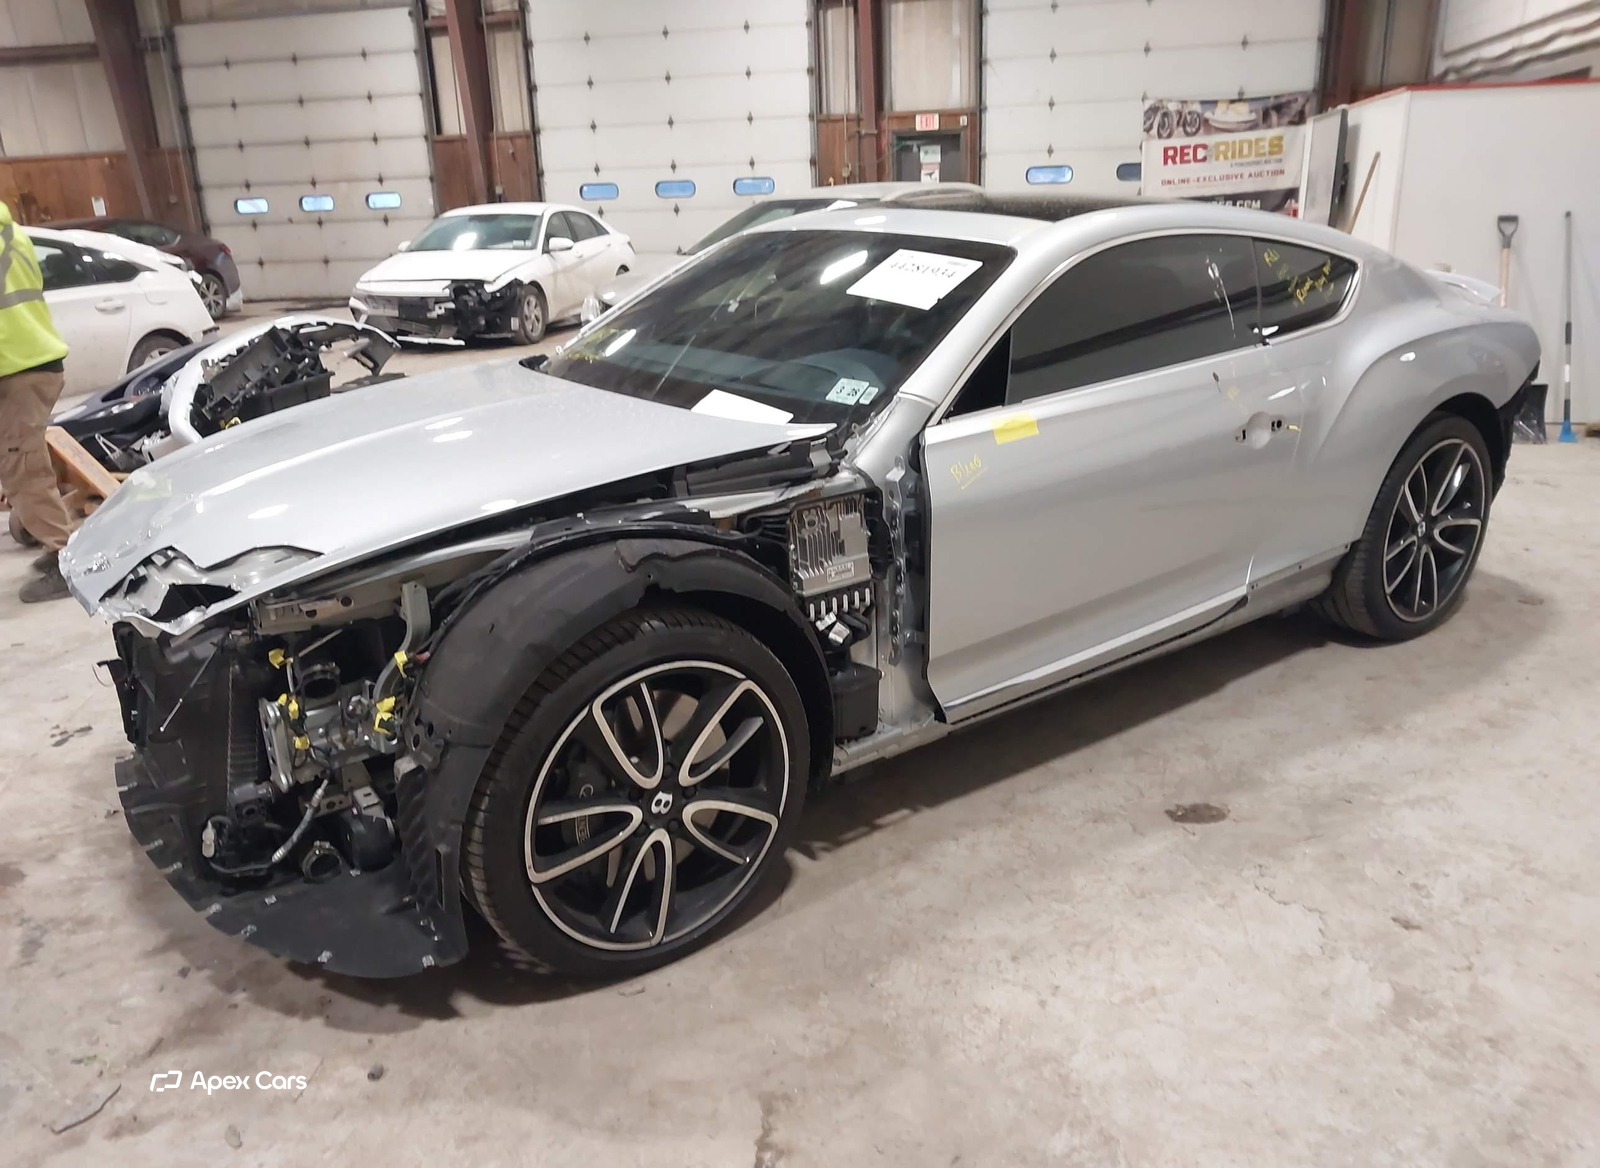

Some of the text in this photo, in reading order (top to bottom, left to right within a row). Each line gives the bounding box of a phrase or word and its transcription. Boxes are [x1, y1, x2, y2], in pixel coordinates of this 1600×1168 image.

[1163, 135, 1284, 166] REC RIDES
[1161, 168, 1286, 186] ONLINE-EXCLUSIVE AUCTION
